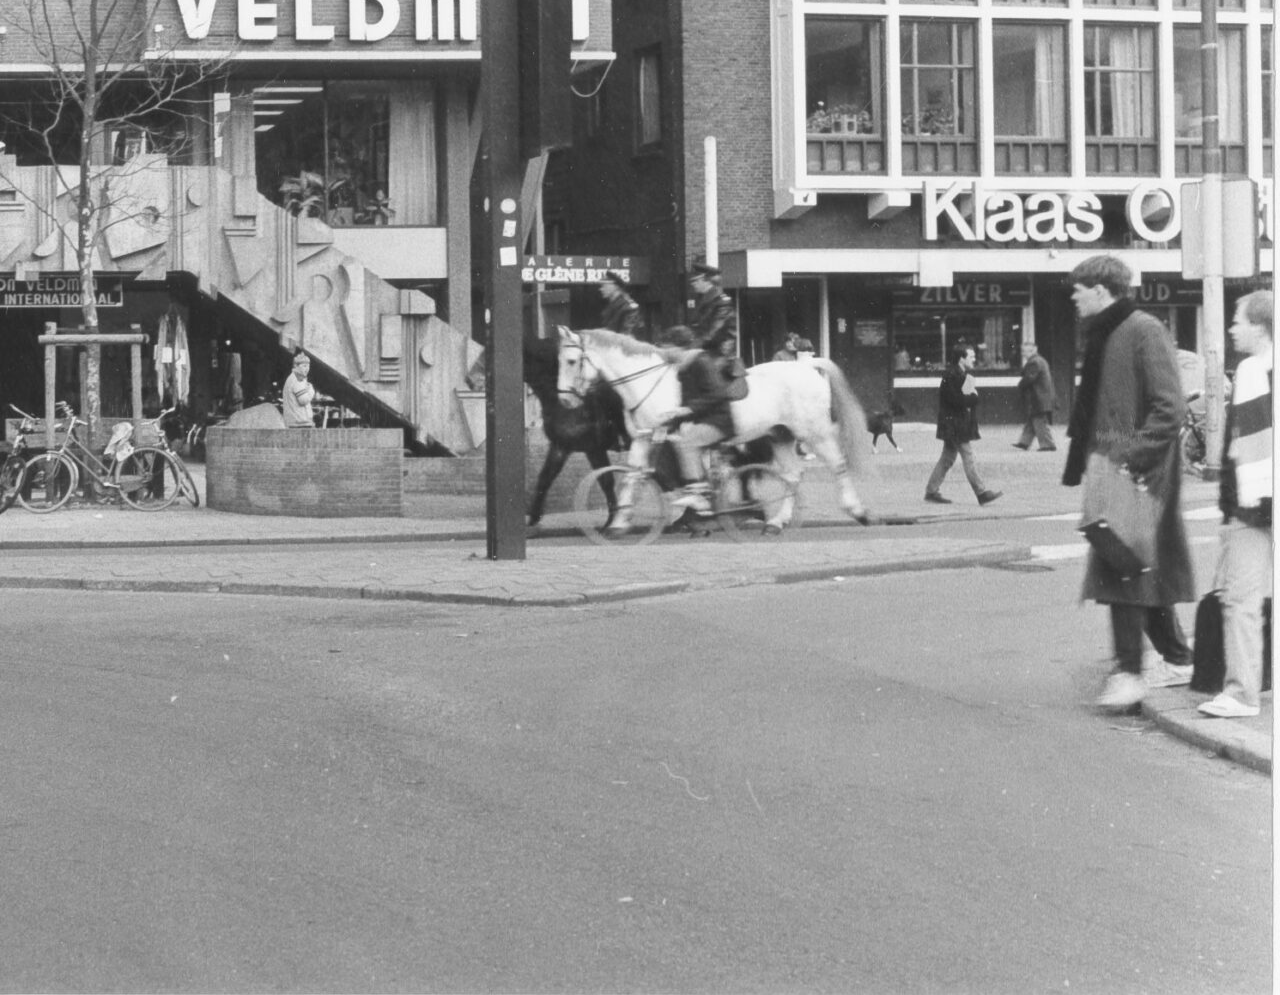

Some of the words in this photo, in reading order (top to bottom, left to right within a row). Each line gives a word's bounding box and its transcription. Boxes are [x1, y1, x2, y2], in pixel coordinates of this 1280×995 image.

[922, 181, 1104, 243] Klaas
[528, 257, 631, 267] ALERIE
[26, 278, 98, 292] VELDMN
[4, 293, 116, 305] INTERNATIOAL
[920, 283, 1003, 303] ZILVER
